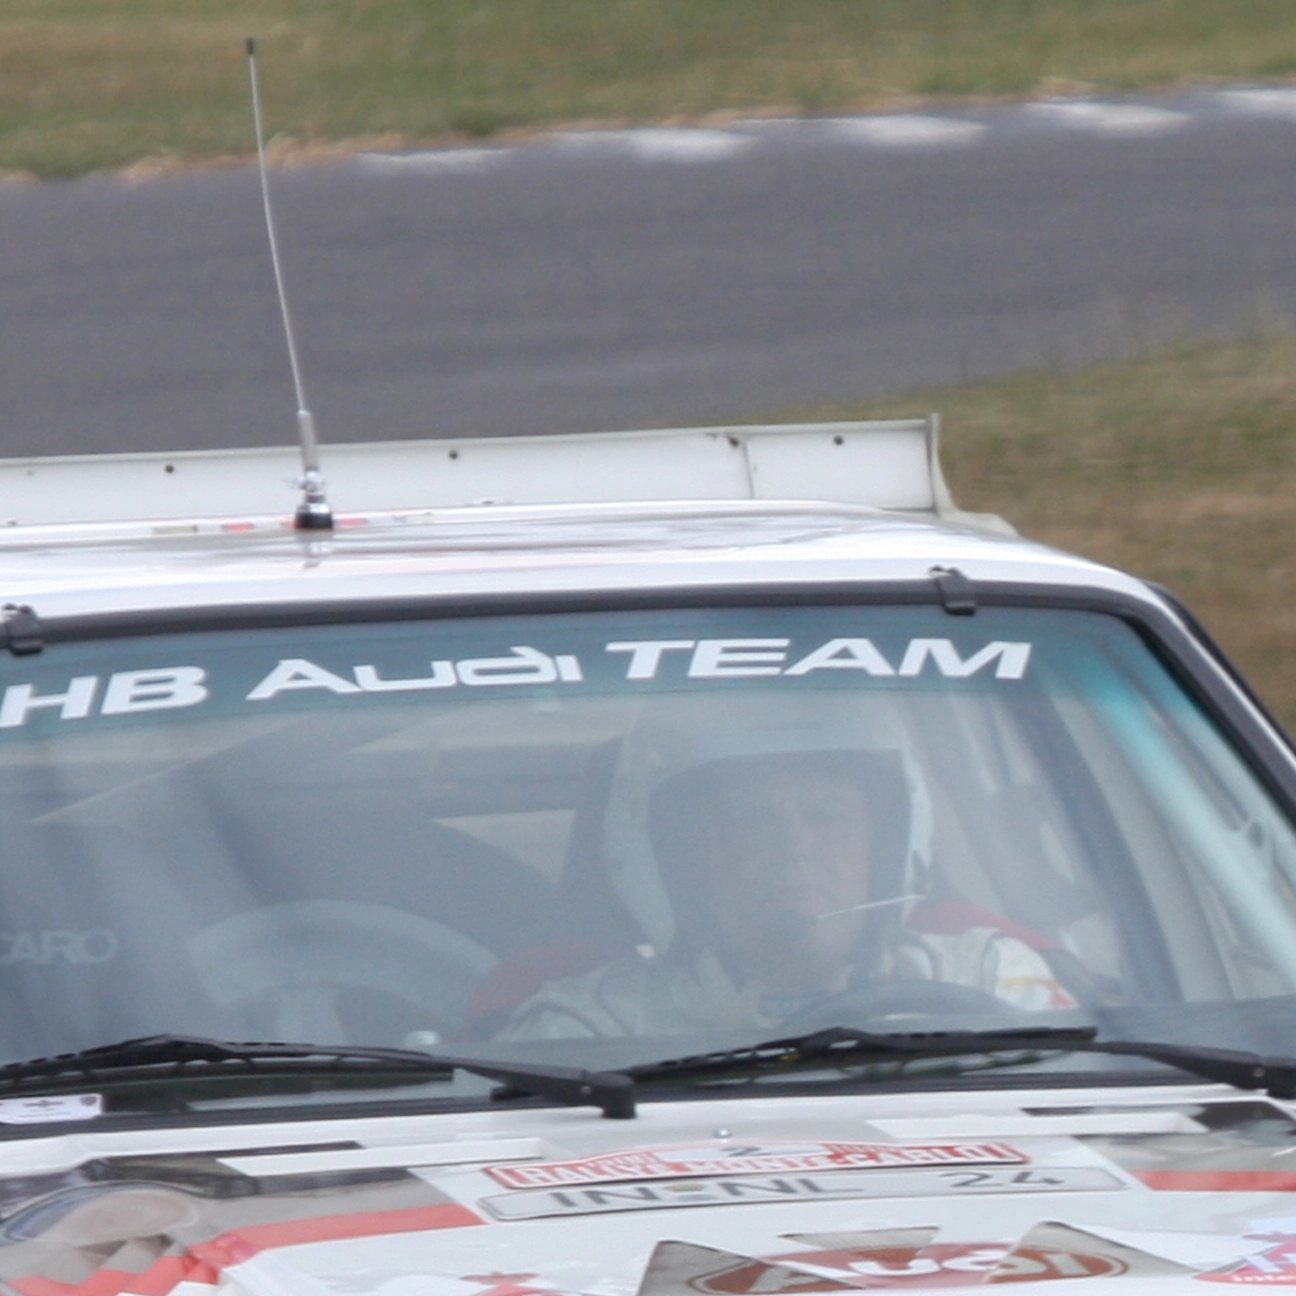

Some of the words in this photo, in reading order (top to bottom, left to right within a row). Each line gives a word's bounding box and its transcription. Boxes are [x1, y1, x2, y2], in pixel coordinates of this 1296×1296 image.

[245, 646, 583, 701] Audi
[605, 638, 1034, 680] TEAM
[516, 1162, 671, 1184] RALLYE
[935, 1171, 1067, 1190] 24
